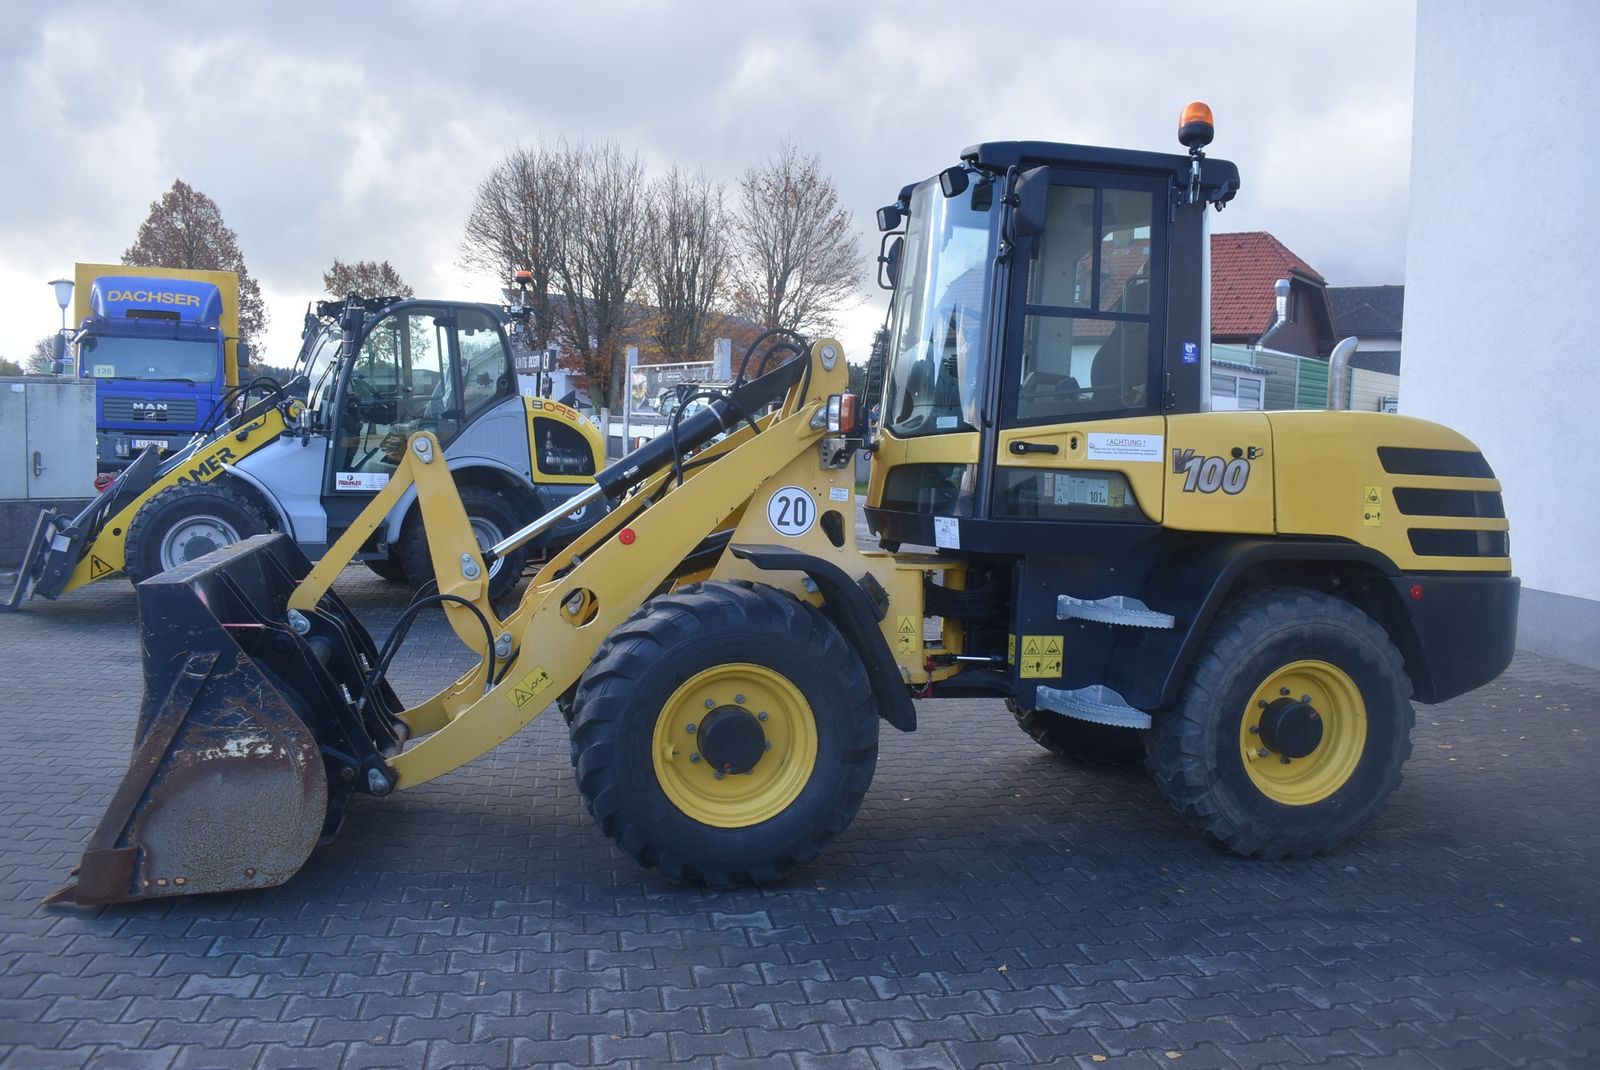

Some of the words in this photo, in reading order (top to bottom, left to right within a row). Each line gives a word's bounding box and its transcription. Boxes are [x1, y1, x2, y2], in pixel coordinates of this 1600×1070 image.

[107, 290, 200, 306] DACHSER
[132, 402, 168, 411] MAN
[532, 400, 577, 422] 8095
[1109, 438, 1142, 447] ACHTUNG
[1089, 491, 1102, 503] 101
[777, 495, 807, 527] 20
